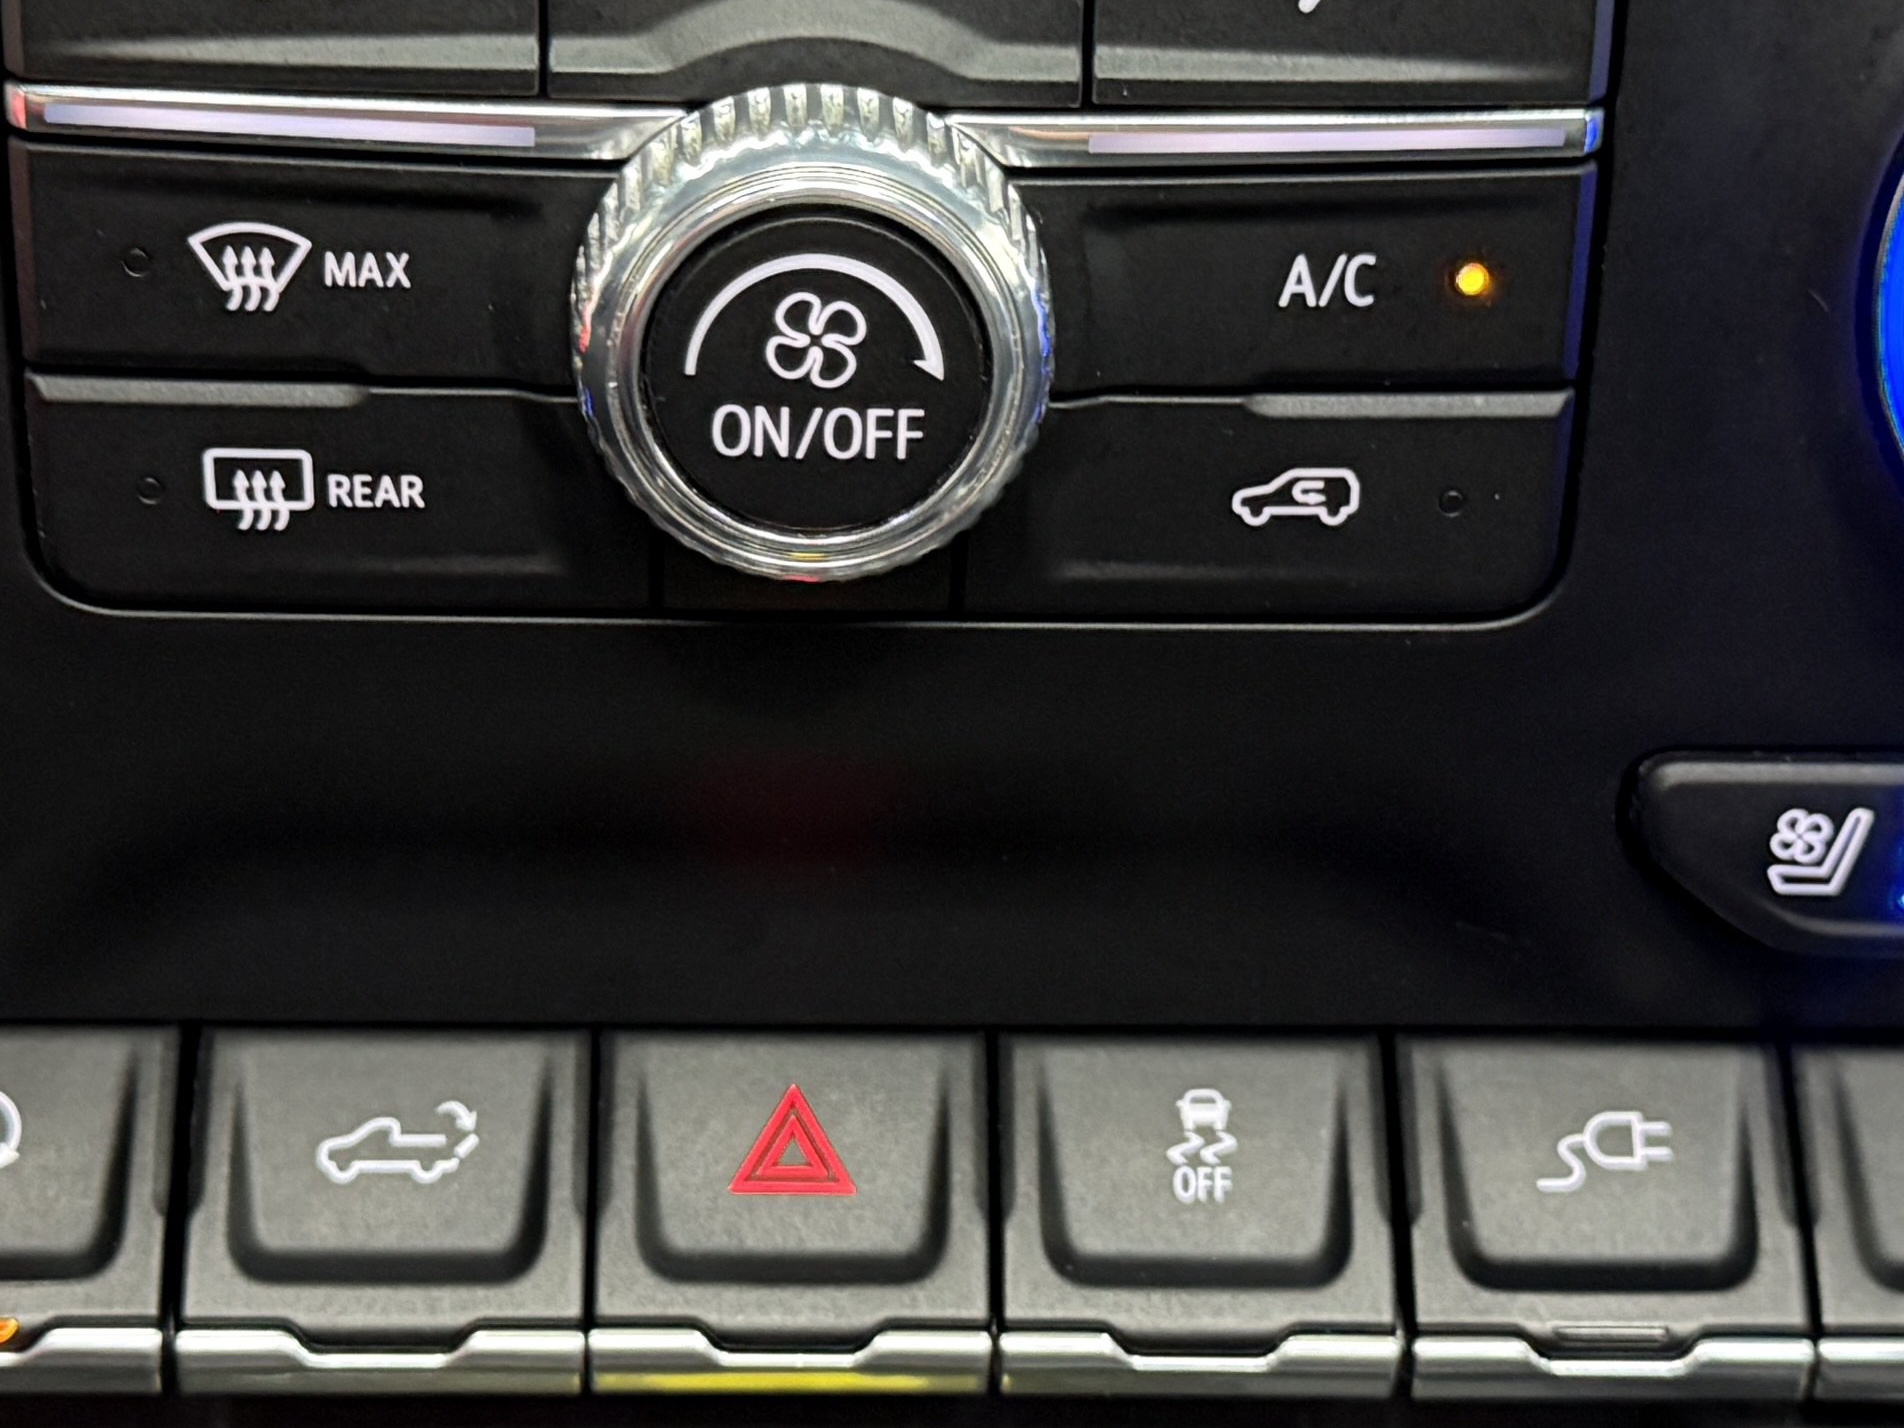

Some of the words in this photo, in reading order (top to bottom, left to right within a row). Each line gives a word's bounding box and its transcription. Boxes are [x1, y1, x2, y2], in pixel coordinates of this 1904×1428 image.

[322, 250, 413, 290] MAX
[1277, 252, 1378, 311] A/C
[709, 402, 927, 464] ON/OFF
[326, 472, 427, 511] REAR
[1172, 1164, 1233, 1205] OFF
